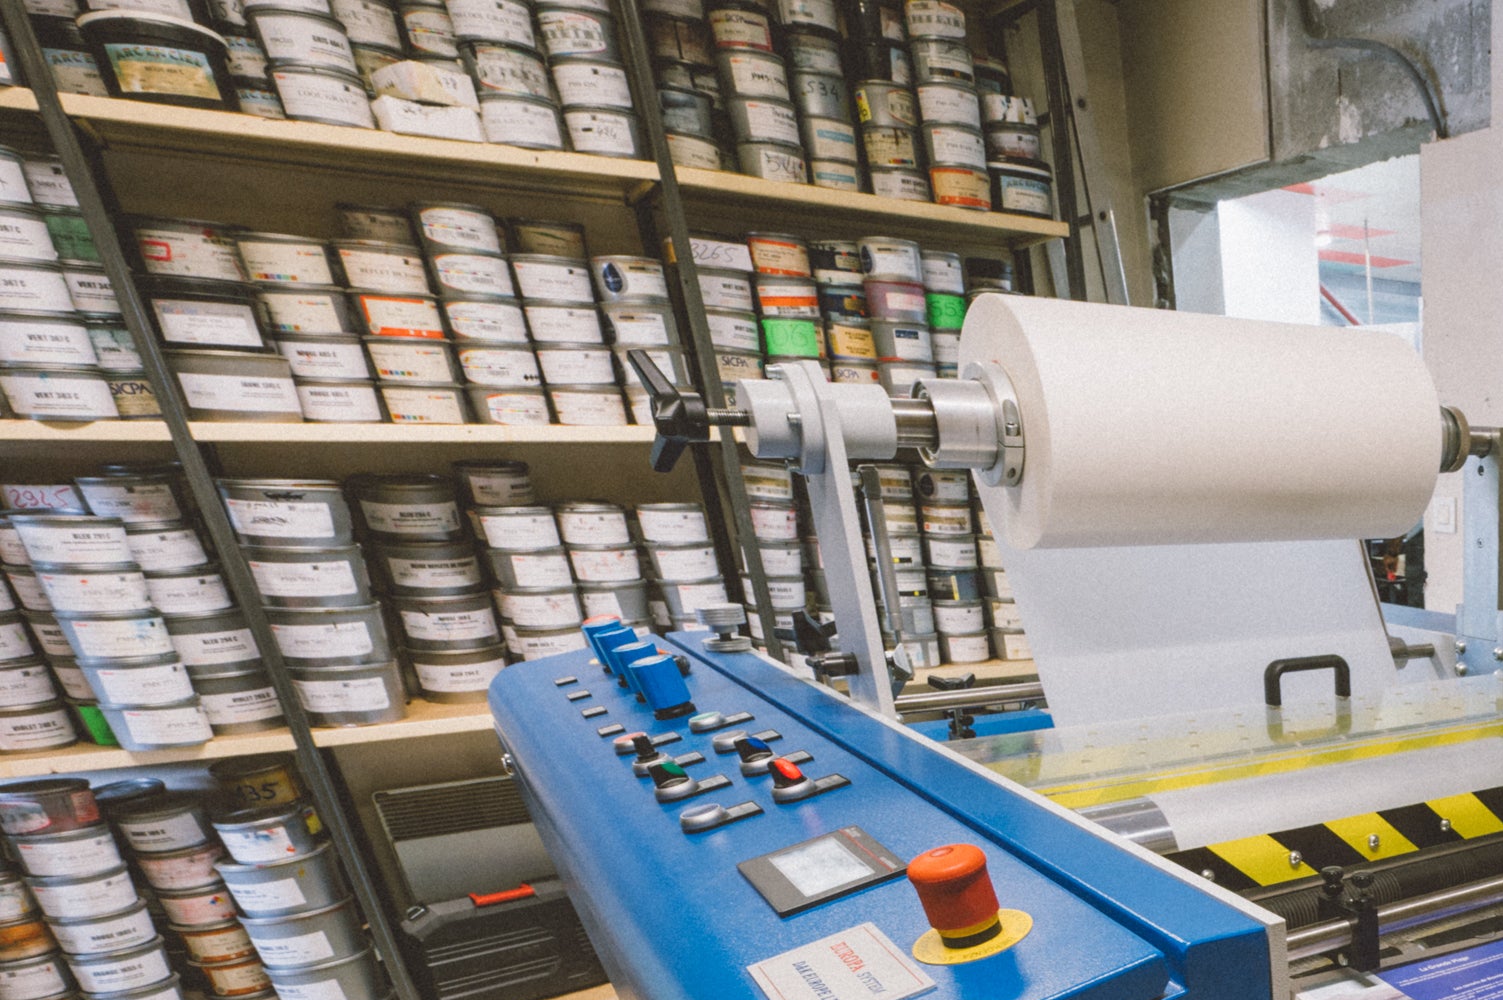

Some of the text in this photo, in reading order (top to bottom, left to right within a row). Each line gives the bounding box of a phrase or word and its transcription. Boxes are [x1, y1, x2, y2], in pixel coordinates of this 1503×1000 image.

[27, 334, 48, 342] VERT
[108, 382, 153, 395] SICPA
[829, 941, 887, 995] EUROPA SYSTEM
[802, 969, 831, 999] EUROPE
